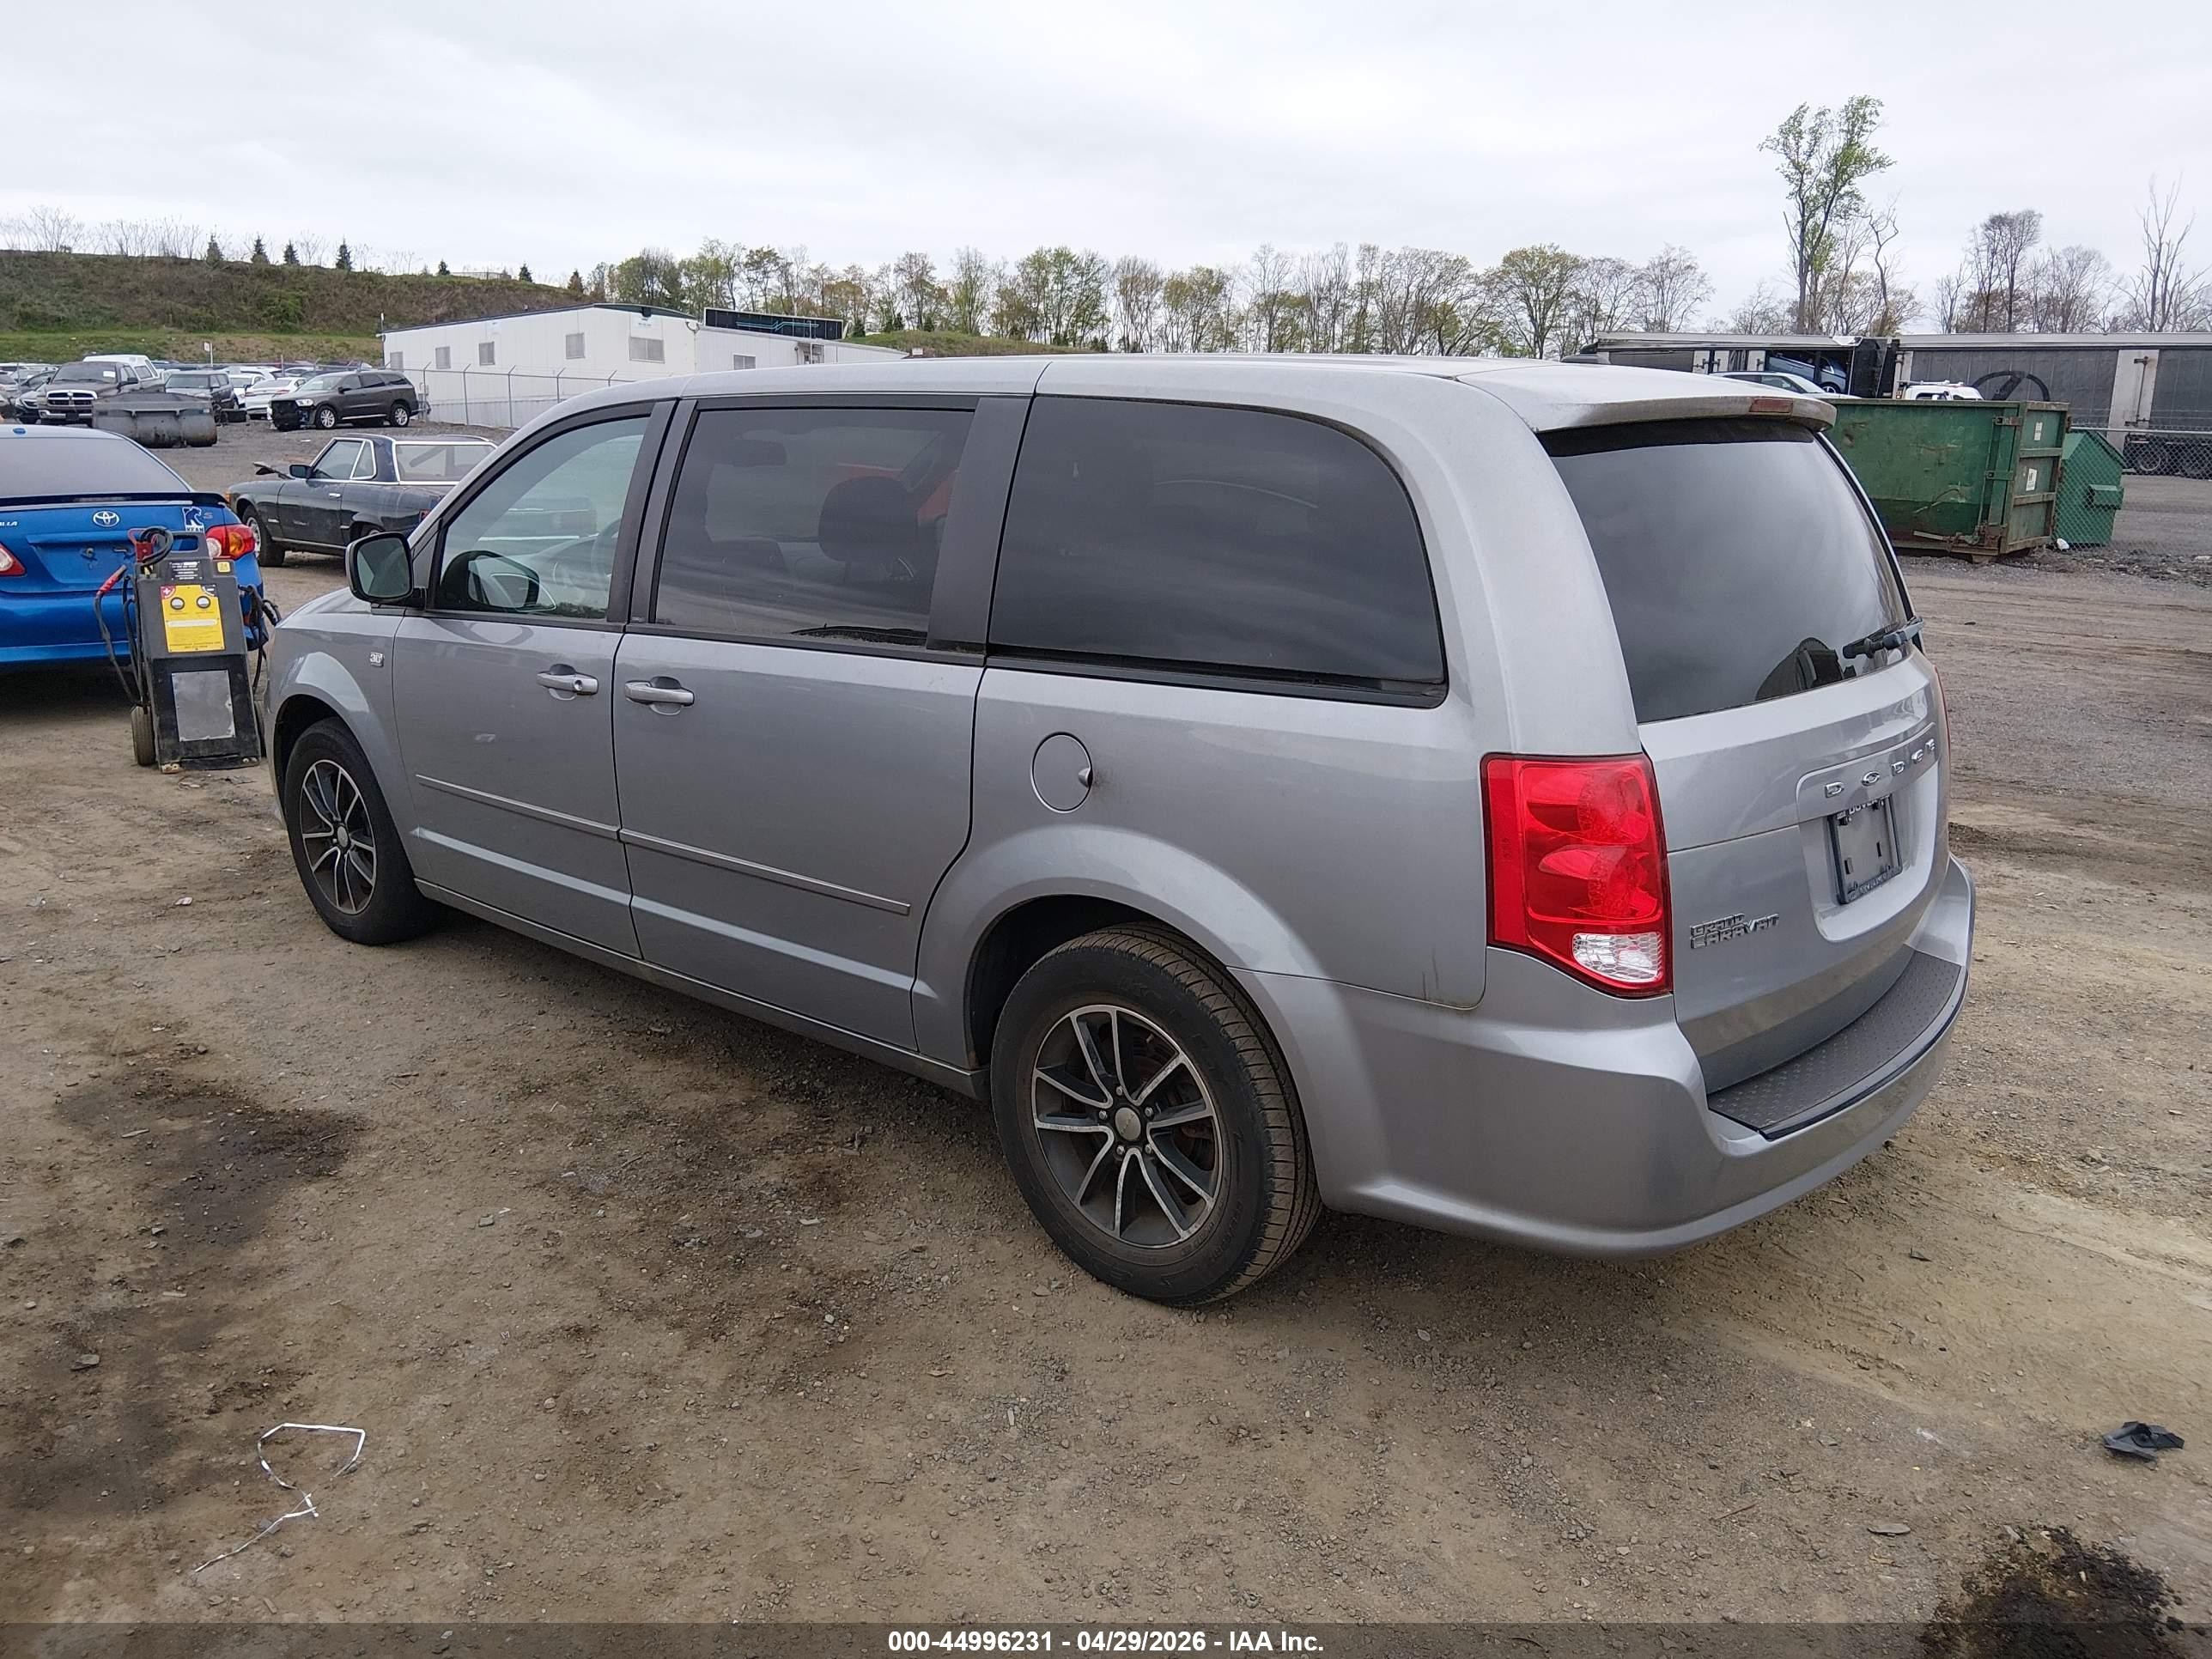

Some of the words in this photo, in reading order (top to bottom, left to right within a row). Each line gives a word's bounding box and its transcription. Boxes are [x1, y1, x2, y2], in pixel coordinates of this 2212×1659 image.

[1825, 738, 1936, 799] DODGE
[1690, 913, 1745, 937] GRAND
[1690, 913, 1780, 949] CARAVAN
